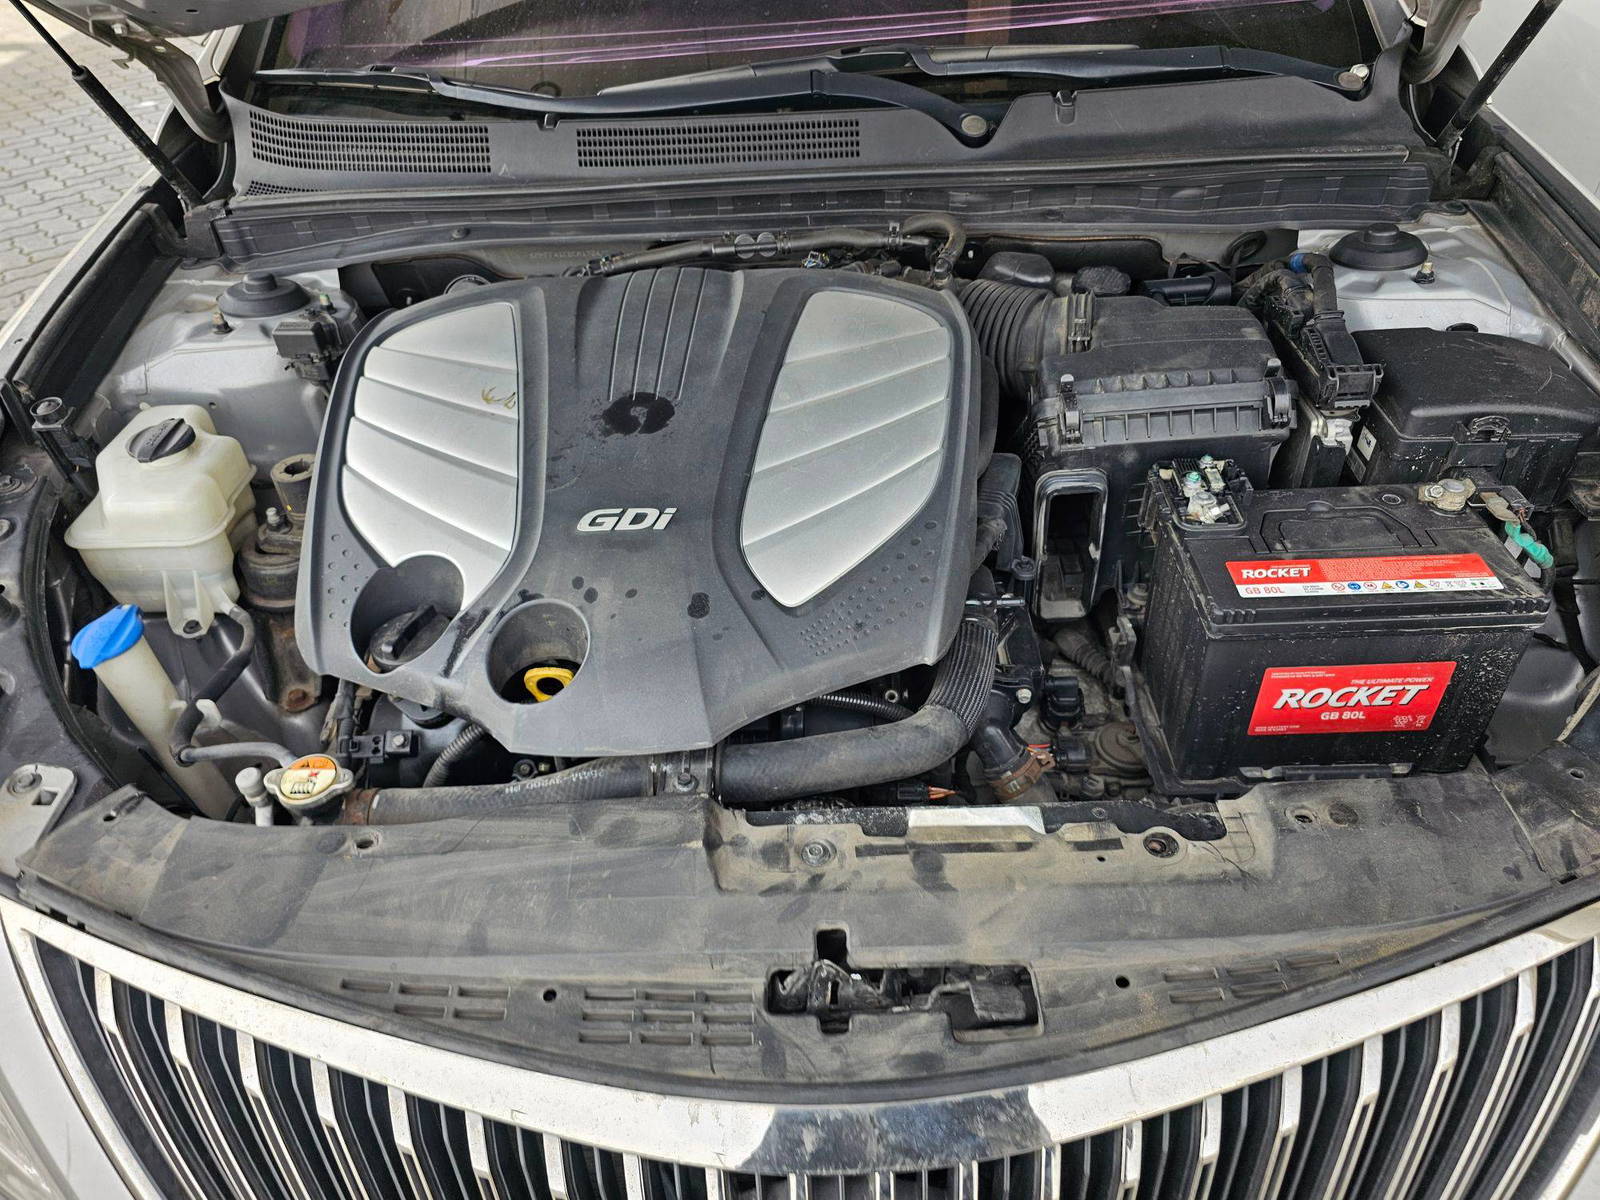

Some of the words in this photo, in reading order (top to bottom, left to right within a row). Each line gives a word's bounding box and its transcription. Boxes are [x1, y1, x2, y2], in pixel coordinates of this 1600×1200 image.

[577, 507, 678, 532] GDi
[1241, 567, 1311, 579] ROCKET
[1245, 586, 1261, 595] GB
[1263, 586, 1285, 595] 80L
[1273, 684, 1430, 710] ROCKET
[1320, 711, 1340, 721] GB
[1342, 710, 1366, 720] 80L
